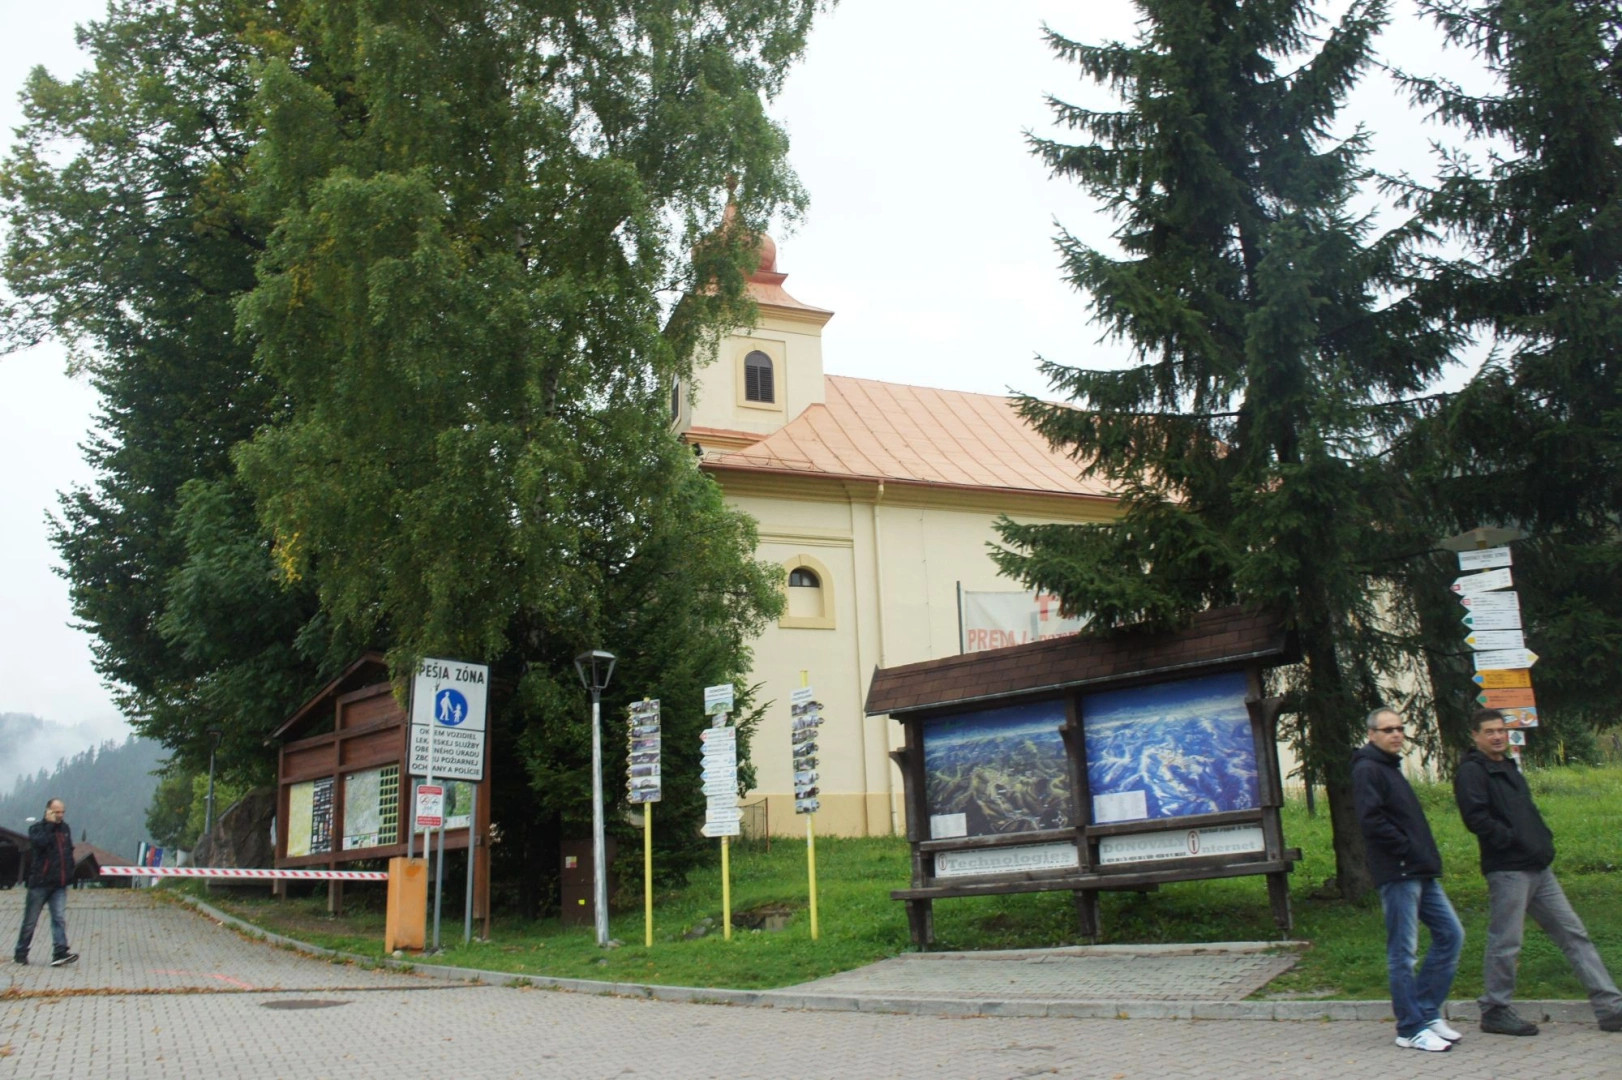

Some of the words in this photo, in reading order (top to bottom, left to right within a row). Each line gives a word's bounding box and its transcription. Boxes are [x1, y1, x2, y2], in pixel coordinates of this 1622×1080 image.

[455, 666, 484, 684] ZÓNA
[419, 728, 445, 736] OKEM
[454, 740, 480, 749] SLUŽBY
[415, 745, 454, 756] OBENÉHO
[411, 763, 447, 772] OCHANY
[454, 766, 481, 776] POLÍCIE
